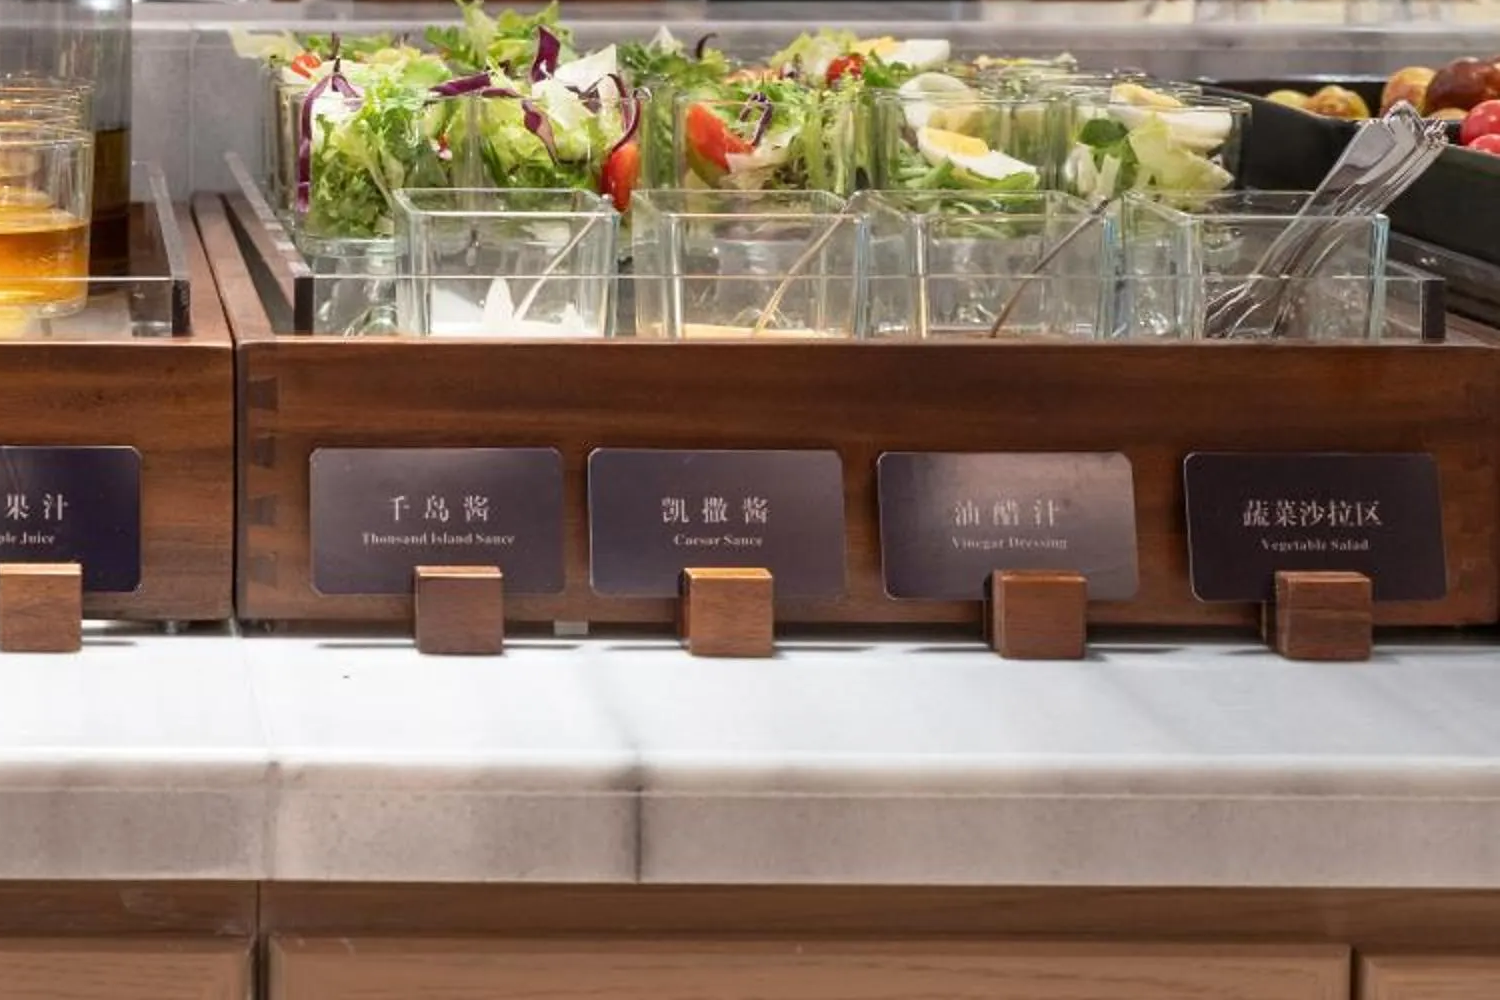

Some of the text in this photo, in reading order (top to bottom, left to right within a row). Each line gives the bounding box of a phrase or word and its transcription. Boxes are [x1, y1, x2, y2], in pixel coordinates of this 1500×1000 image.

[388, 495, 489, 522] 千岛酱
[661, 496, 769, 524] 凯撒酱
[953, 499, 1060, 526] 油醋汁
[1242, 499, 1383, 527] 蔬菜沙拉区
[19, 532, 55, 546] Juice
[362, 532, 514, 545] Thousand Island Sauce
[672, 534, 763, 546] Caesar Sauce
[951, 535, 1068, 549] Vinegar Dressing
[1261, 538, 1368, 551] Vegetable Salad
